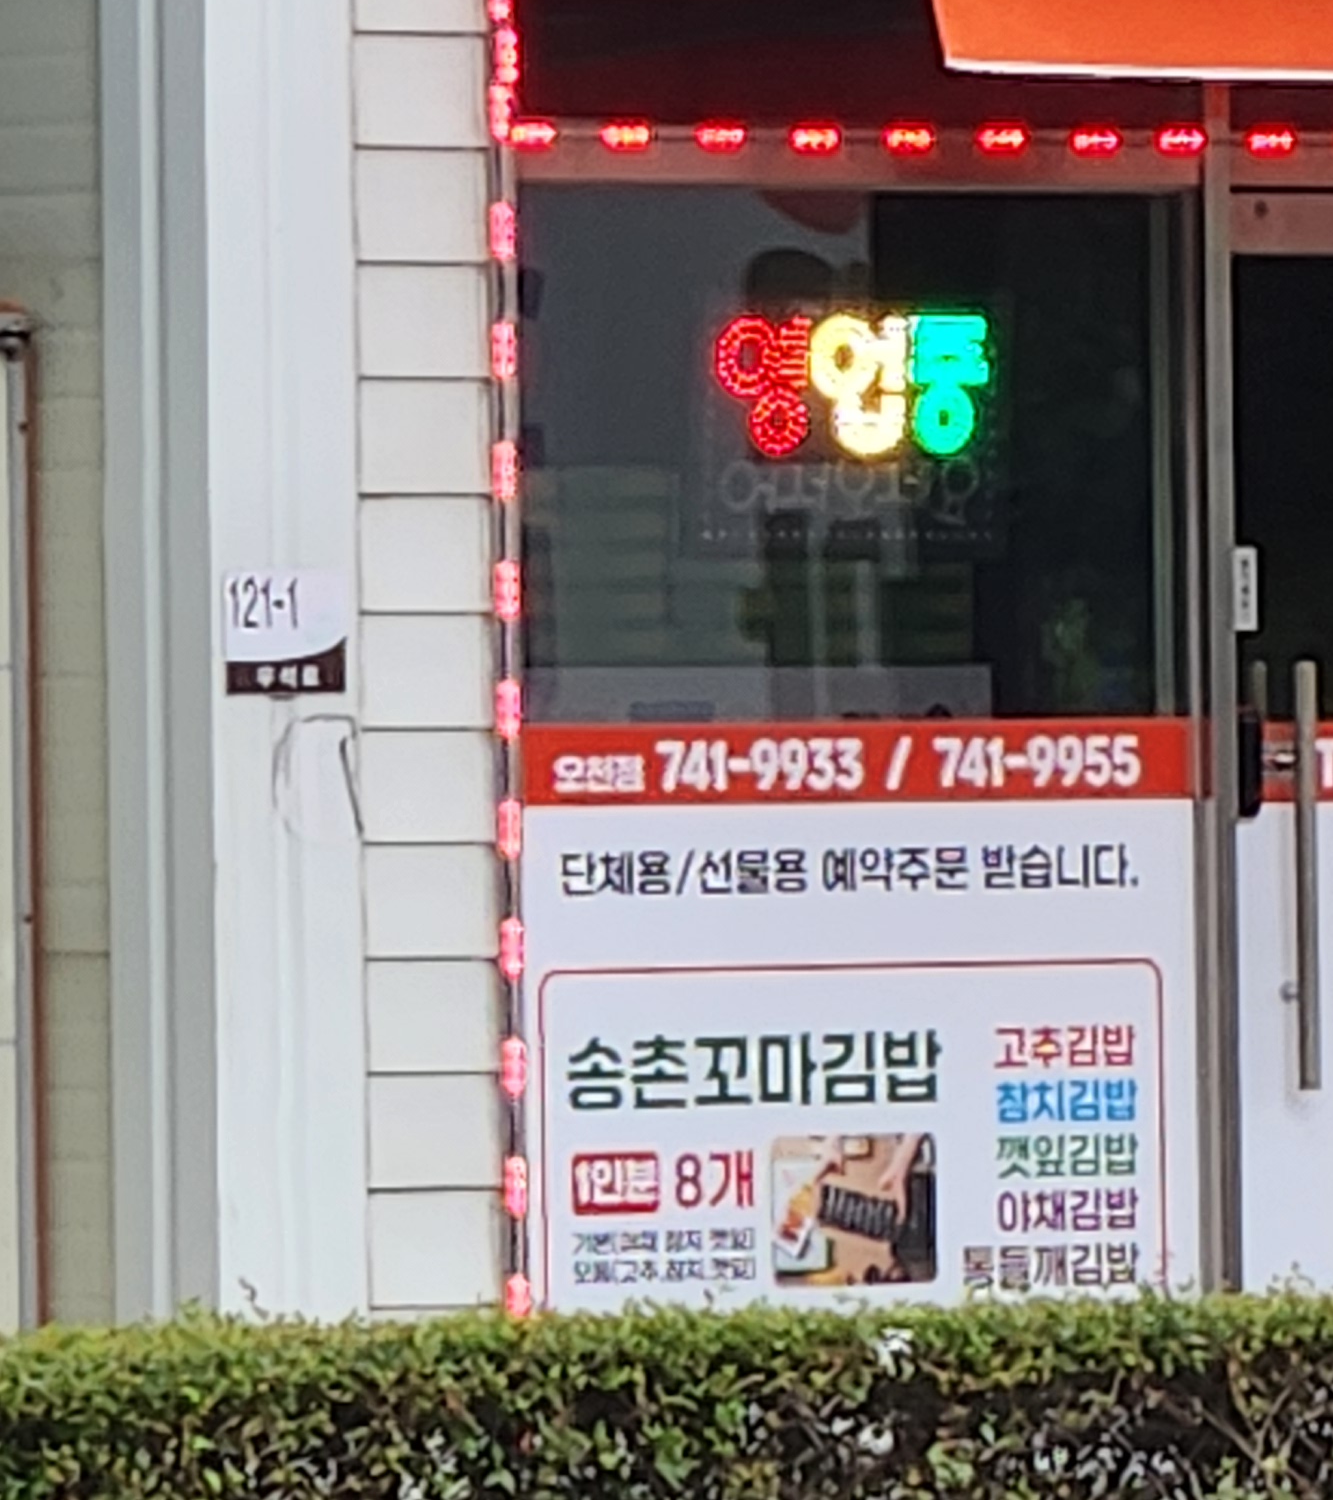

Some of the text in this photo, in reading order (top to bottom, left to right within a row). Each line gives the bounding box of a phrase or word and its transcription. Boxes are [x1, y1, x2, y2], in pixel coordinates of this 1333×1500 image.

[229, 576, 298, 630] 121-1
[552, 733, 1140, 793] 오천점 741-9933 / 741-9955
[560, 842, 1139, 896] 단체용/선물용 예약주문 받습니다.
[566, 1028, 942, 1111] 송촌꼬마김밥
[993, 1024, 1136, 1070] 고추김밥
[996, 1078, 1139, 1123] 참치김밥
[675, 1149, 755, 1208] 8개
[996, 1133, 1139, 1180] 깻잎김밥
[997, 1186, 1139, 1234] 야채김밥
